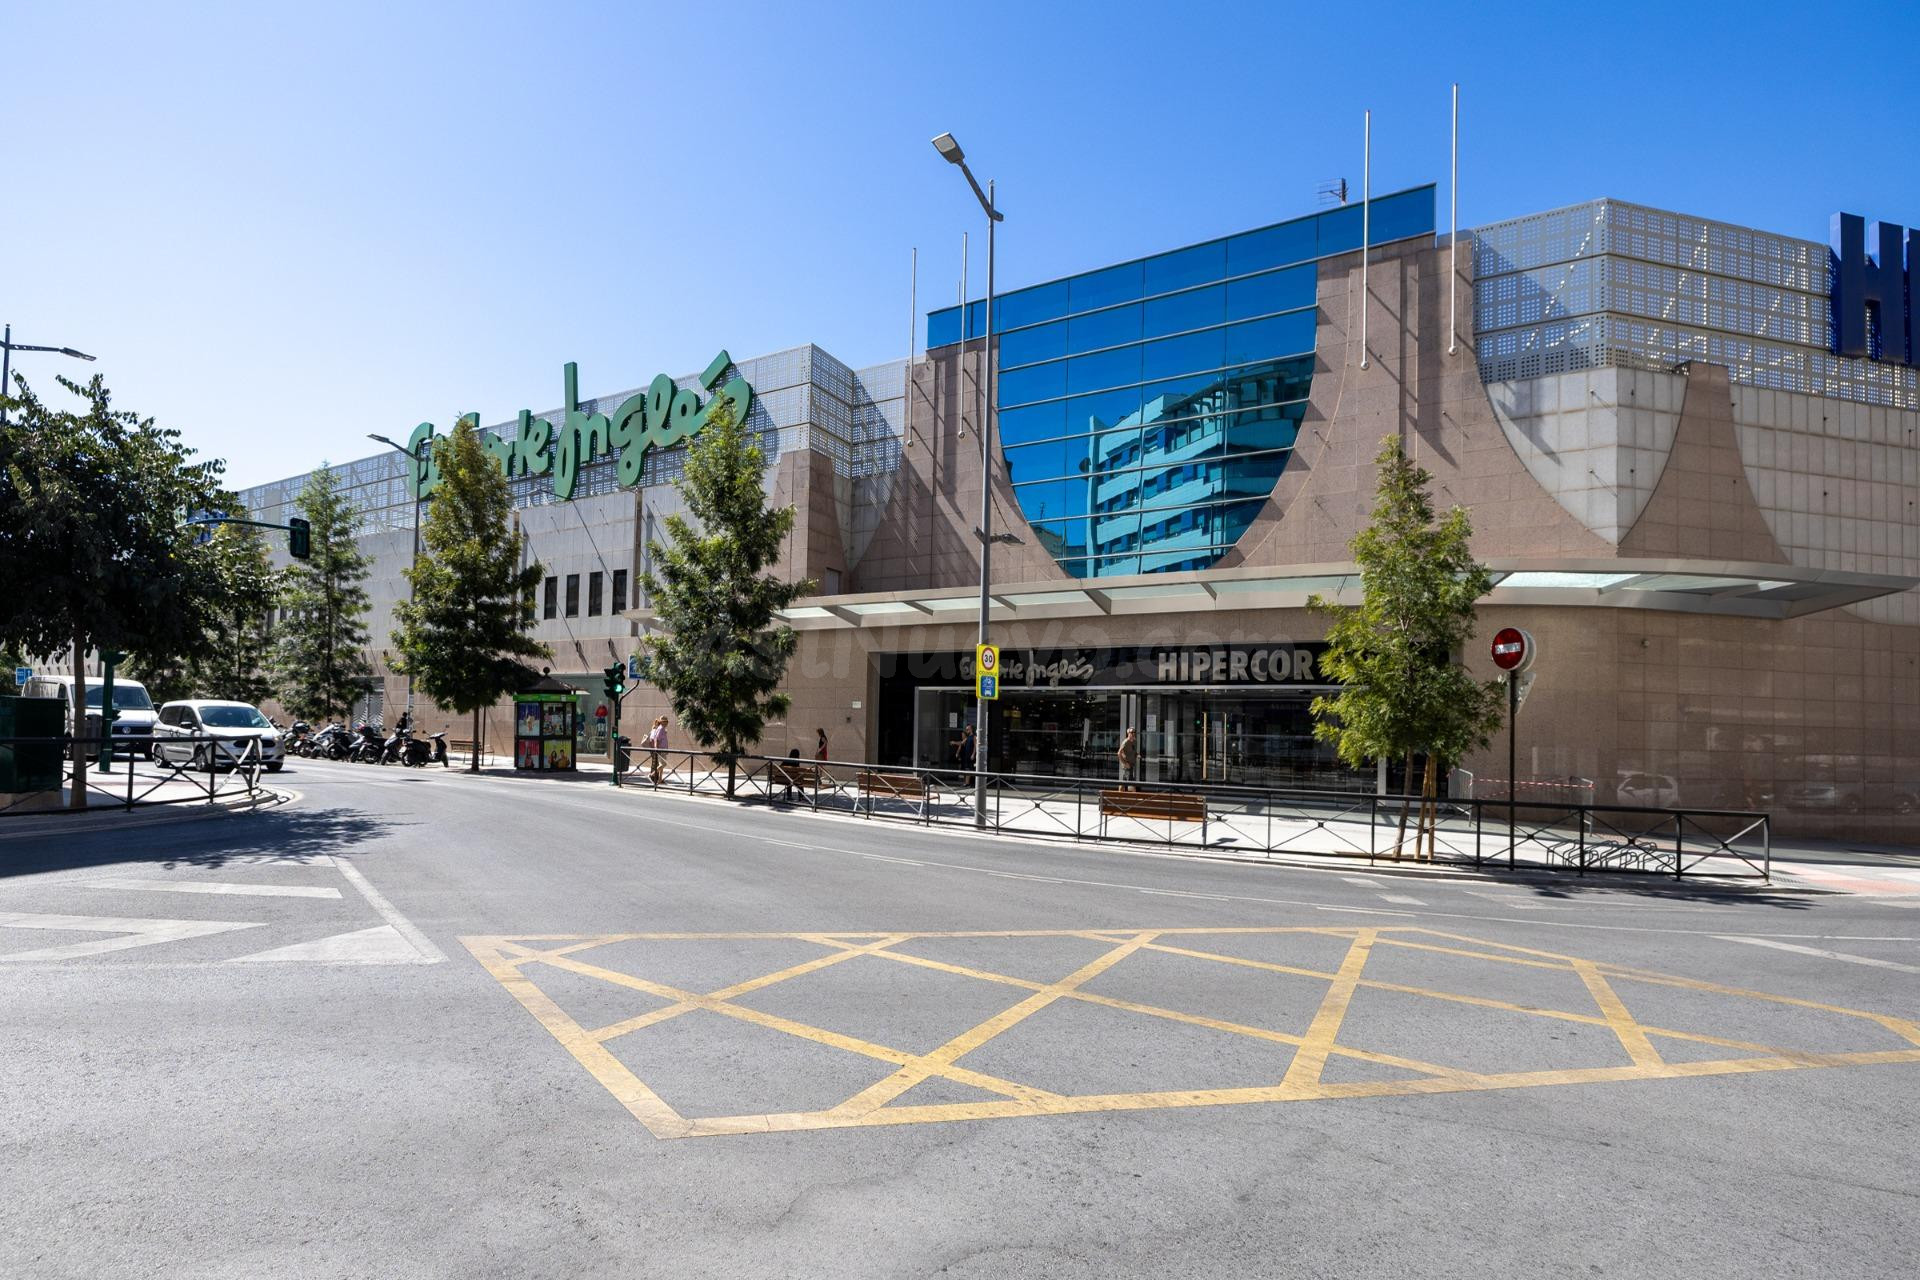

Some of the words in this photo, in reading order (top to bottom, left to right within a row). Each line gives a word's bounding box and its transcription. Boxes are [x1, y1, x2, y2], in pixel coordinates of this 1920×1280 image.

[554, 349, 753, 500] Inglés
[984, 654, 993, 663] 30
[1025, 649, 1095, 688] Inglés
[1158, 649, 1315, 682] HIPERCOR
